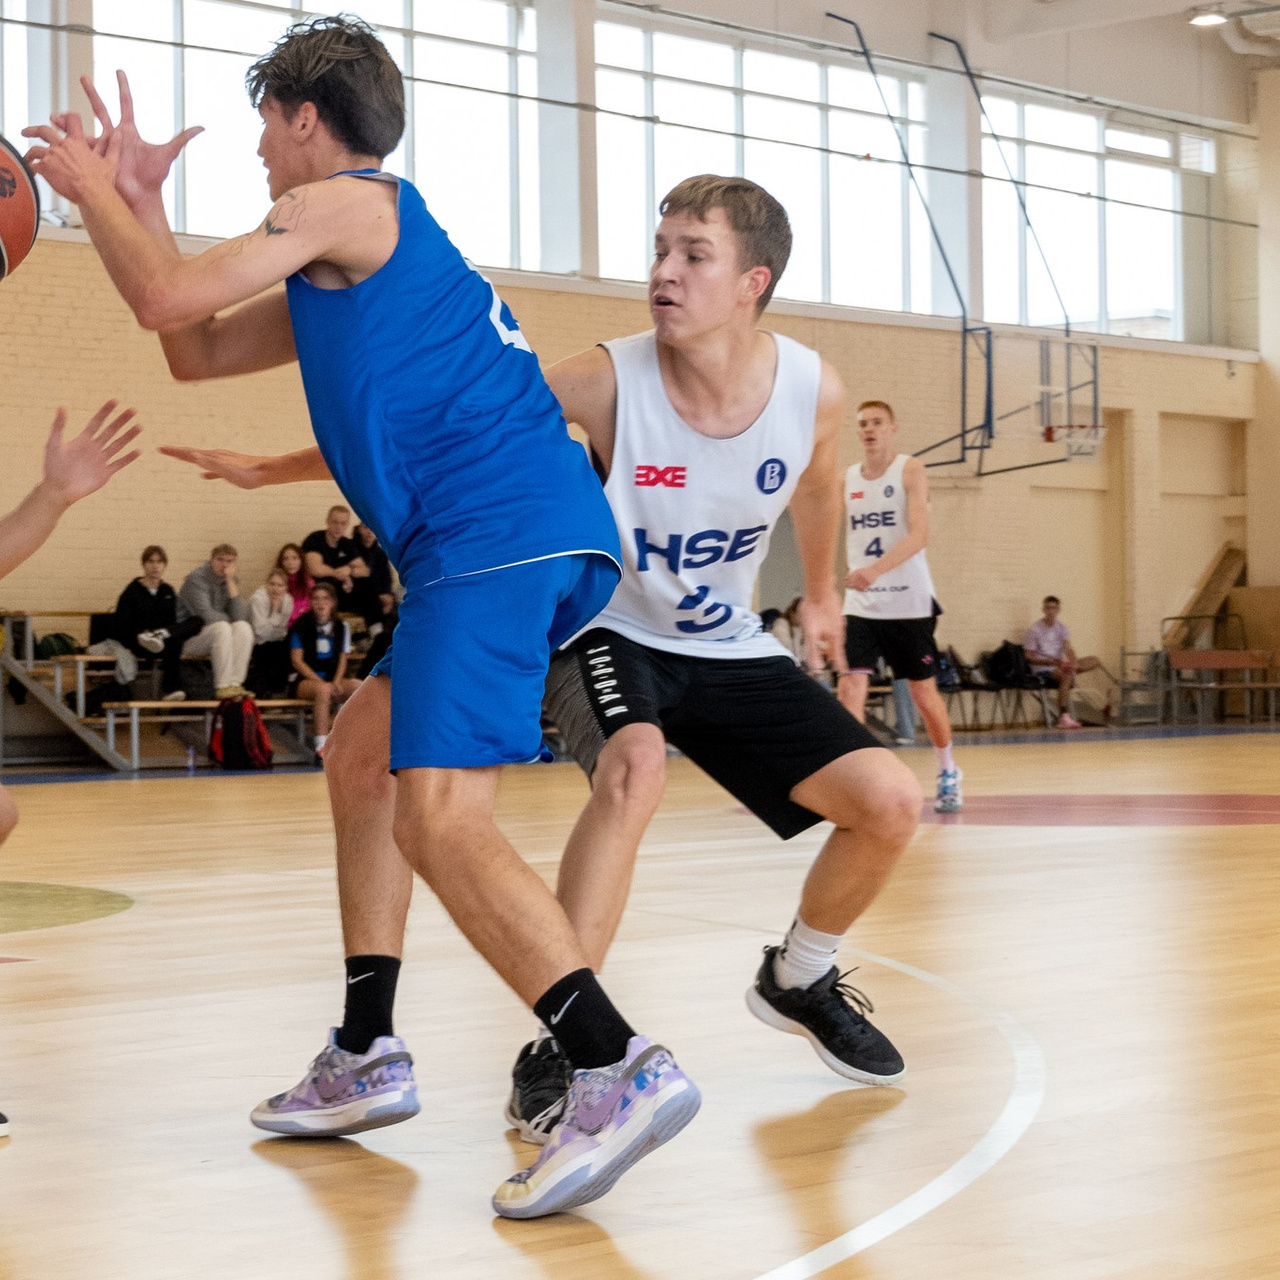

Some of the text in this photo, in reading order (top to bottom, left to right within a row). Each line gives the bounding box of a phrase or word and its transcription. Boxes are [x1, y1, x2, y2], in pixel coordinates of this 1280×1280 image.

[851, 511, 897, 531] HSE
[634, 524, 768, 576] HSE
[864, 537, 885, 558] 4
